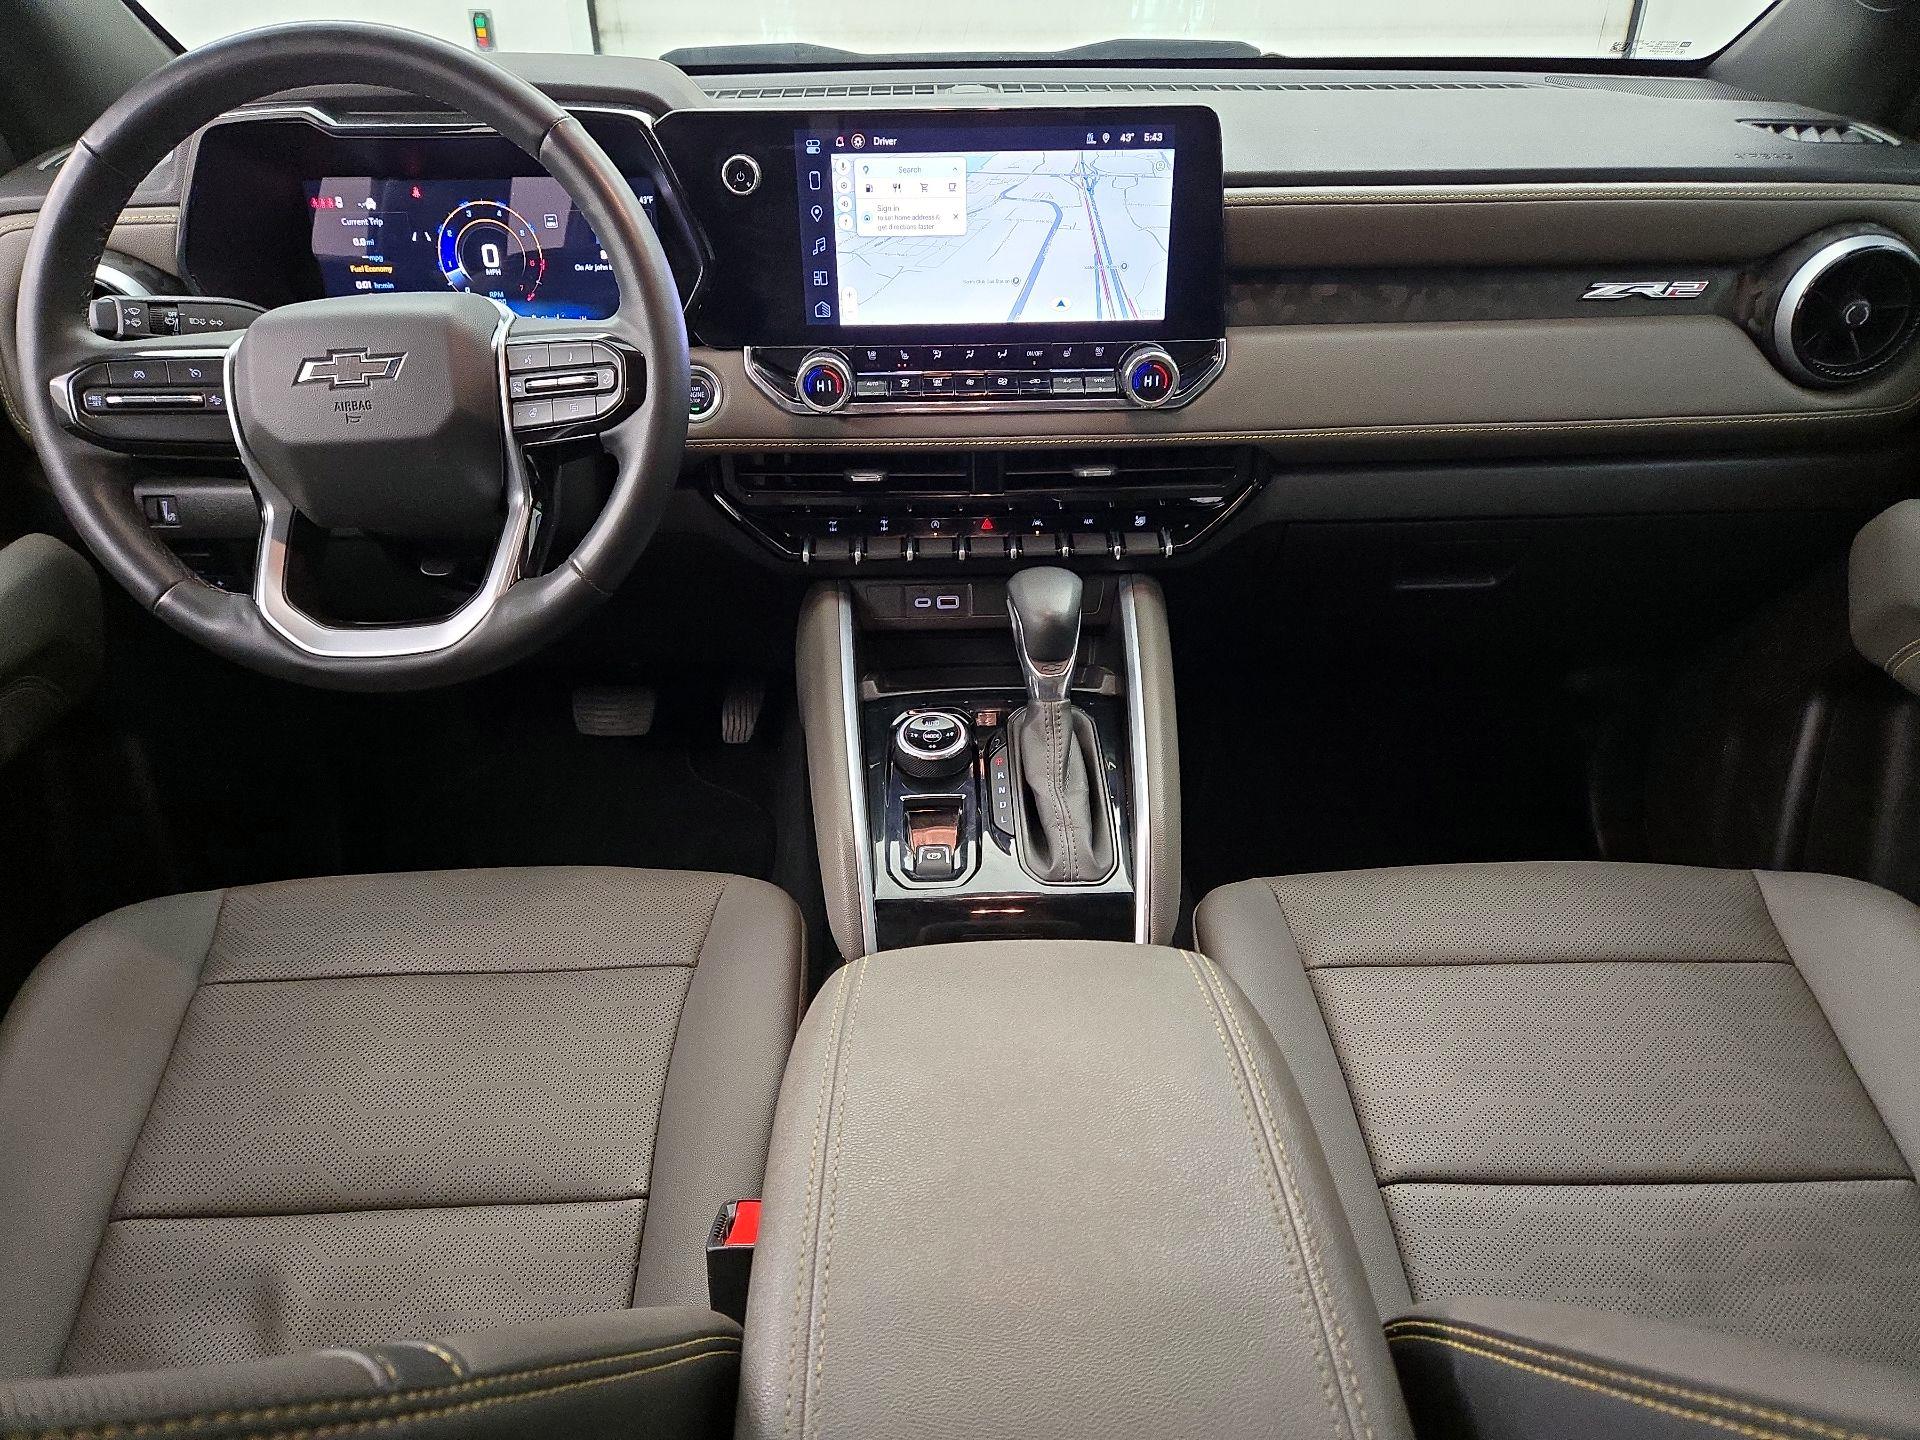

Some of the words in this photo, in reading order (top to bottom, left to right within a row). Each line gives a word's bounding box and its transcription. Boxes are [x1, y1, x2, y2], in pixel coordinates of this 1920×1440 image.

[873, 137, 897, 146] Driver
[1144, 133, 1163, 142] 5:43
[877, 205, 892, 213] Sign
[466, 210, 472, 218] 3
[341, 217, 369, 226] Current
[369, 217, 384, 228] Trip
[480, 243, 500, 268] 0
[350, 265, 364, 273] Fuel
[364, 265, 393, 274] Economy
[574, 264, 585, 272] On
[1582, 281, 1709, 299] ZR2
[1144, 375, 1159, 387] HI
[816, 380, 832, 392] HI
[334, 400, 372, 411] AIRBAG
[998, 786, 1006, 794] N
